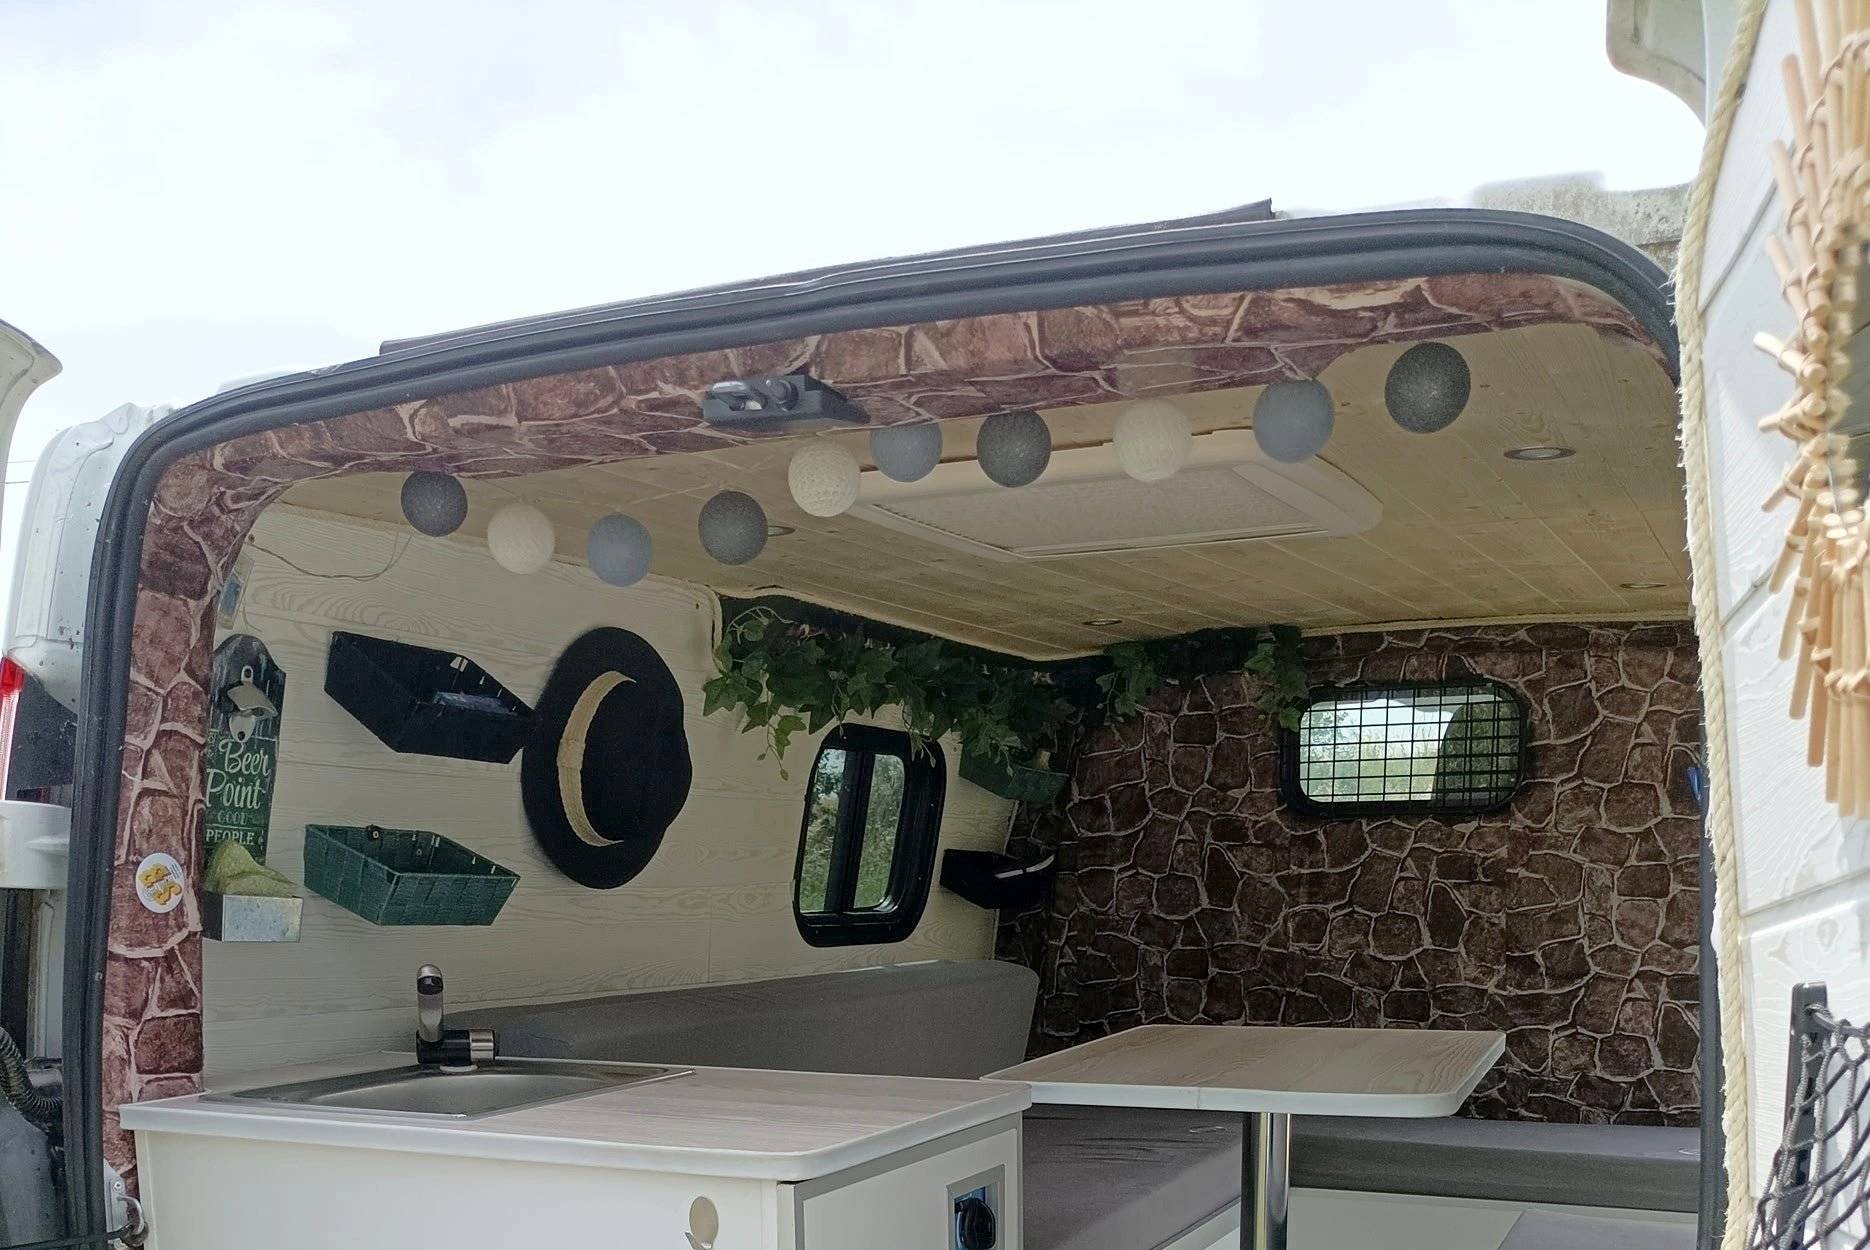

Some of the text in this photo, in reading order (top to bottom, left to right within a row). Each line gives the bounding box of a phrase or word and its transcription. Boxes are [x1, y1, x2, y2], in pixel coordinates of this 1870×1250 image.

[218, 738, 271, 776] Beer
[206, 768, 267, 809] Point
[206, 829, 255, 846] PEOPLE
